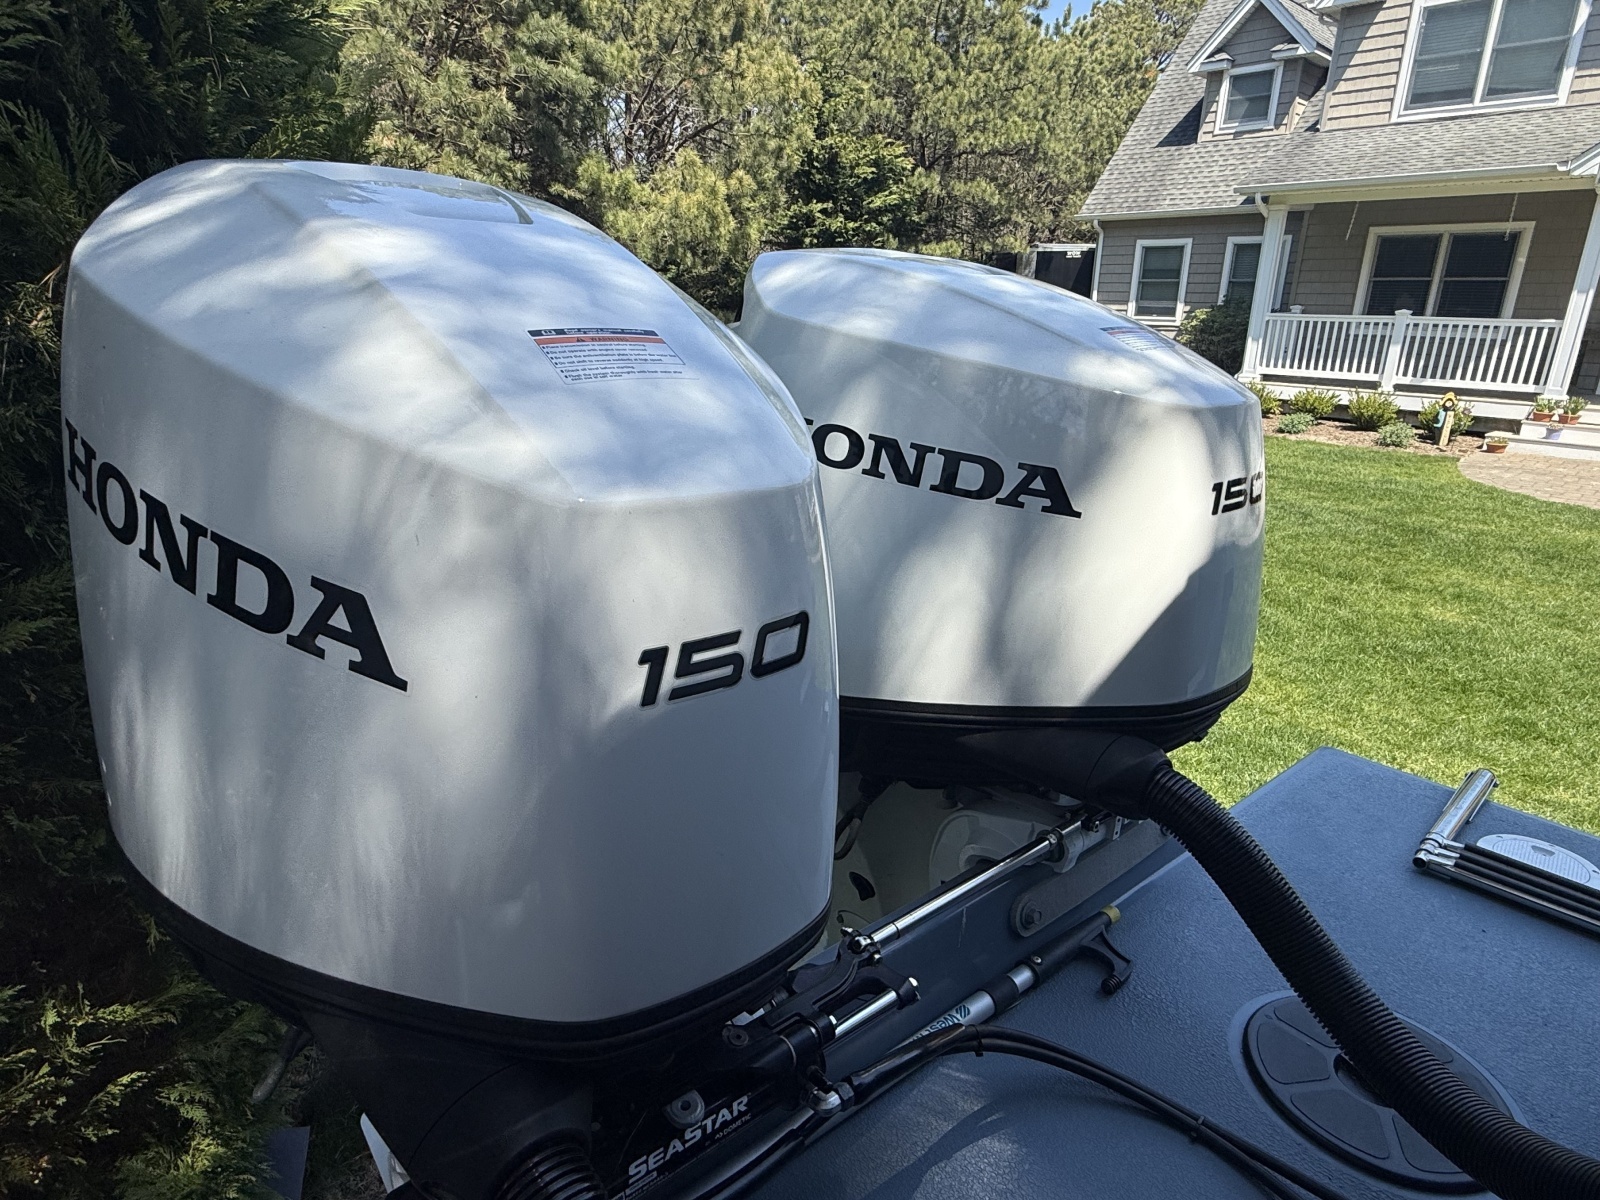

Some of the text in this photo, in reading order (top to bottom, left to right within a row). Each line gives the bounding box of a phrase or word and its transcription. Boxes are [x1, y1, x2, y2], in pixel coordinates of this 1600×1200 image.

[804, 417, 1082, 519] ONDA
[65, 417, 408, 692] HONDA
[638, 611, 809, 707] 150
[629, 1095, 749, 1185] SEASTAR
